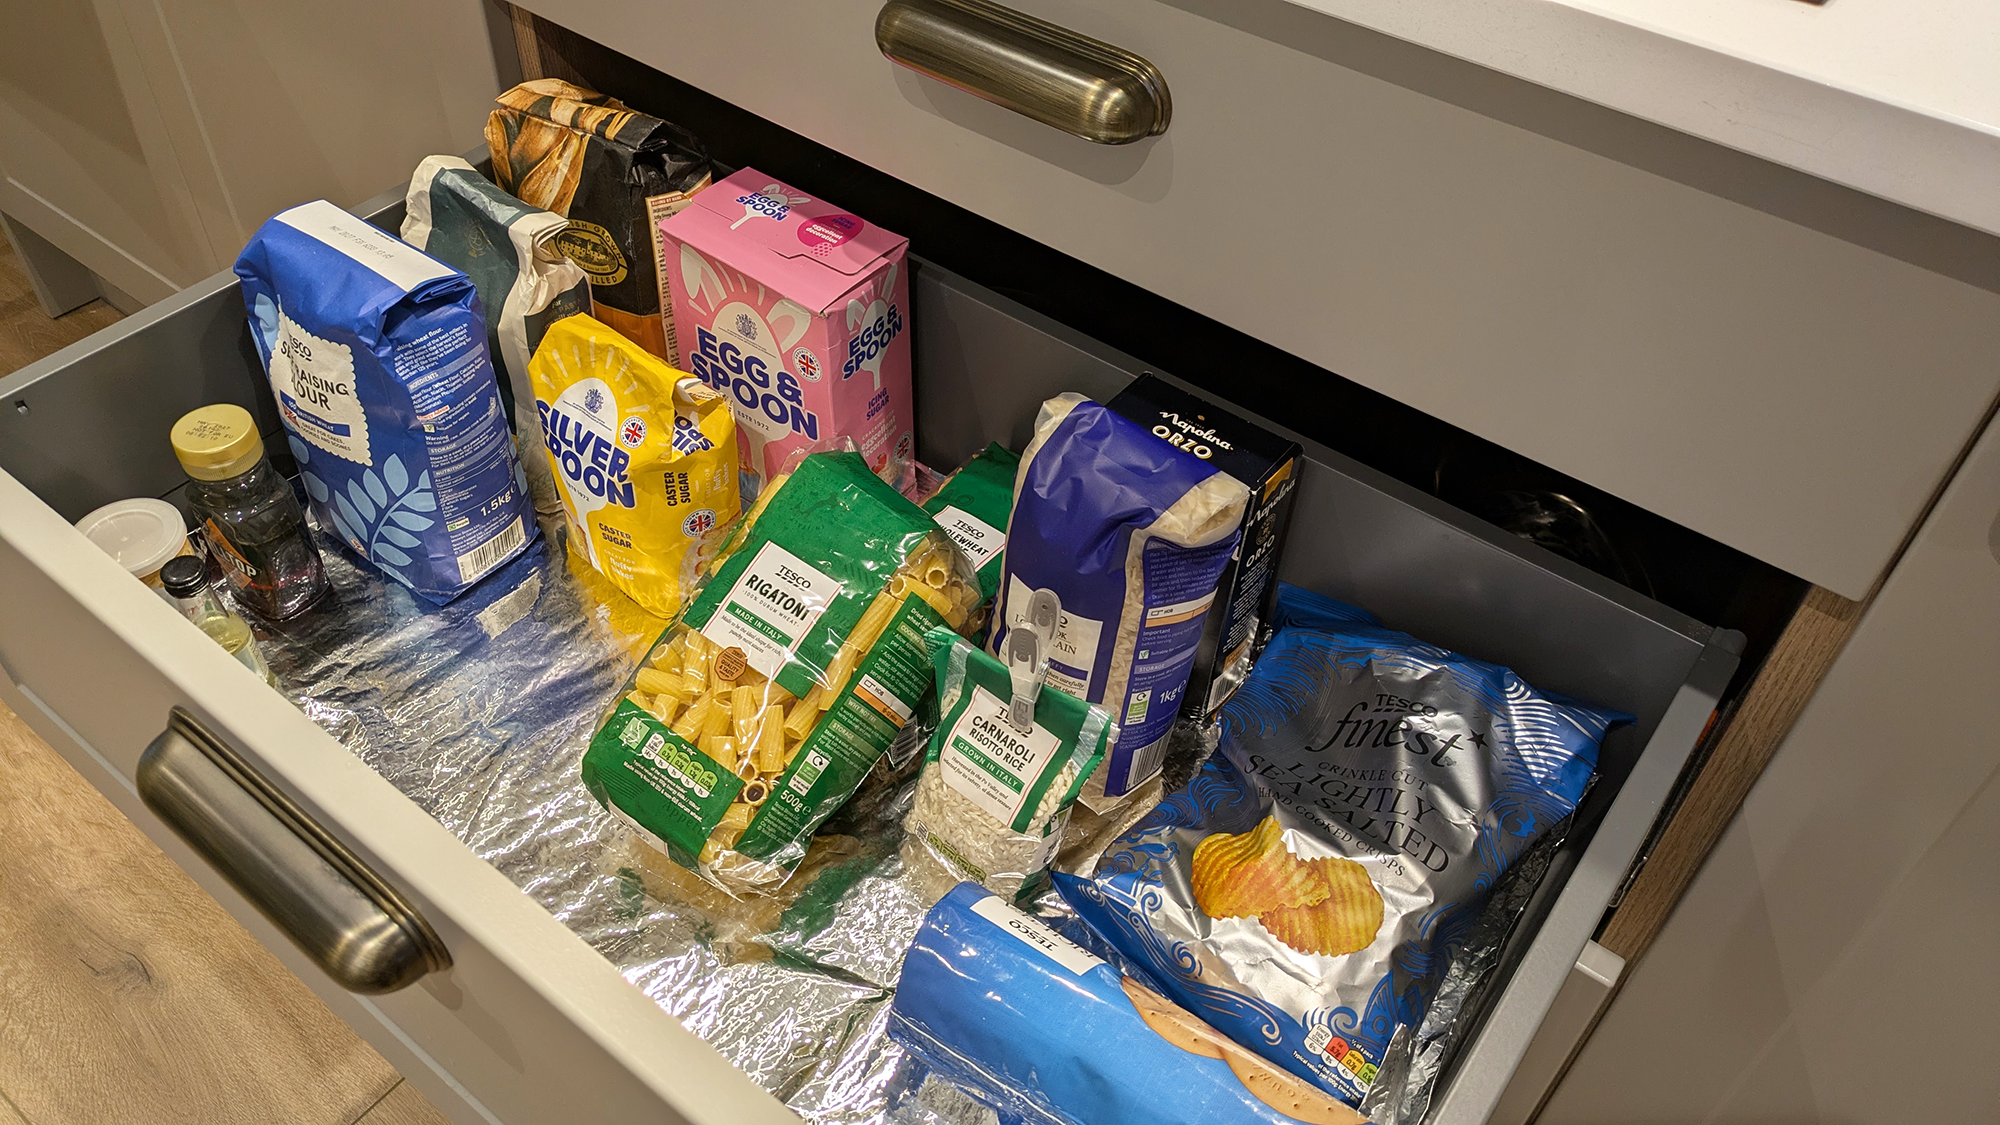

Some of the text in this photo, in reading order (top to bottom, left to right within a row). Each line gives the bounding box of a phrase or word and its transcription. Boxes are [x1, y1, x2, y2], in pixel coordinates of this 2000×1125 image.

[735, 196, 787, 221] SPOON
[748, 192, 790, 213] EGG &
[805, 227, 838, 244] decoration
[591, 276, 617, 284] ILLED
[410, 333, 429, 344] wheat
[438, 332, 449, 340] best
[849, 304, 898, 358] EGG &
[843, 315, 903, 379] SPOON
[697, 327, 770, 389] EGG
[777, 372, 803, 406] &
[690, 352, 819, 441] SPOON
[866, 394, 889, 421] SUGAR
[868, 387, 887, 409] ICING
[753, 417, 770, 432] 1972
[1159, 412, 1231, 449] Napolina
[430, 443, 457, 453] STORAGE
[536, 400, 630, 483] SILVER
[1152, 425, 1213, 460] ORZO
[435, 463, 465, 475] NUTRITION
[664, 472, 677, 506] CASTER
[678, 472, 691, 503] SUGAR
[480, 491, 512, 517] 1.5kg
[599, 522, 632, 540] CASTER
[956, 519, 985, 539] TESCO
[602, 532, 632, 549] SUGAR
[1246, 535, 1276, 567] ORZO
[777, 564, 811, 589] TESCO
[746, 573, 809, 620] RIGATONI
[758, 599, 797, 626] DURUM WHEAT
[905, 613, 921, 626] wheat
[910, 607, 923, 619] Dried
[734, 608, 782, 640] MADE IN ITALY
[899, 624, 922, 642] COOKING
[1143, 628, 1171, 636] Important
[755, 637, 766, 647] shape
[721, 660, 739, 672] QUALITY
[1139, 663, 1165, 673] STORAGE
[874, 687, 884, 696] HOB
[1059, 676, 1085, 688] carefully
[1160, 688, 1178, 704] 1kg
[1376, 694, 1438, 717] TESCO
[847, 699, 870, 718] WHY NOT
[831, 722, 854, 740] STORAGE
[971, 714, 1035, 762] CARNAROLI
[1305, 702, 1464, 767] finest
[812, 744, 833, 761] Recycling
[968, 728, 1025, 771] RISOTTO RICE
[955, 767, 963, 775] for
[957, 742, 1018, 786] GROWN IN ITALY
[950, 756, 971, 772] Harvested
[985, 783, 1000, 794] Valley
[998, 791, 1008, 799] and
[1318, 761, 1428, 791] CRINKLE CUT
[779, 789, 804, 811] 500g
[1285, 762, 1435, 824] LIGHTLY
[1244, 754, 1449, 872] SEA SALTED
[1258, 787, 1405, 876] HAND COOKED CRISPS
[1008, 918, 1054, 951] TESCO
[1315, 1025, 1330, 1038] Energy
[1292, 1050, 1308, 1064] Typical
[1306, 1062, 1320, 1074] values
[1318, 1072, 1327, 1080] per
[1345, 1059, 1357, 1070] 0.7g
[1362, 1049, 1374, 1059] pack
